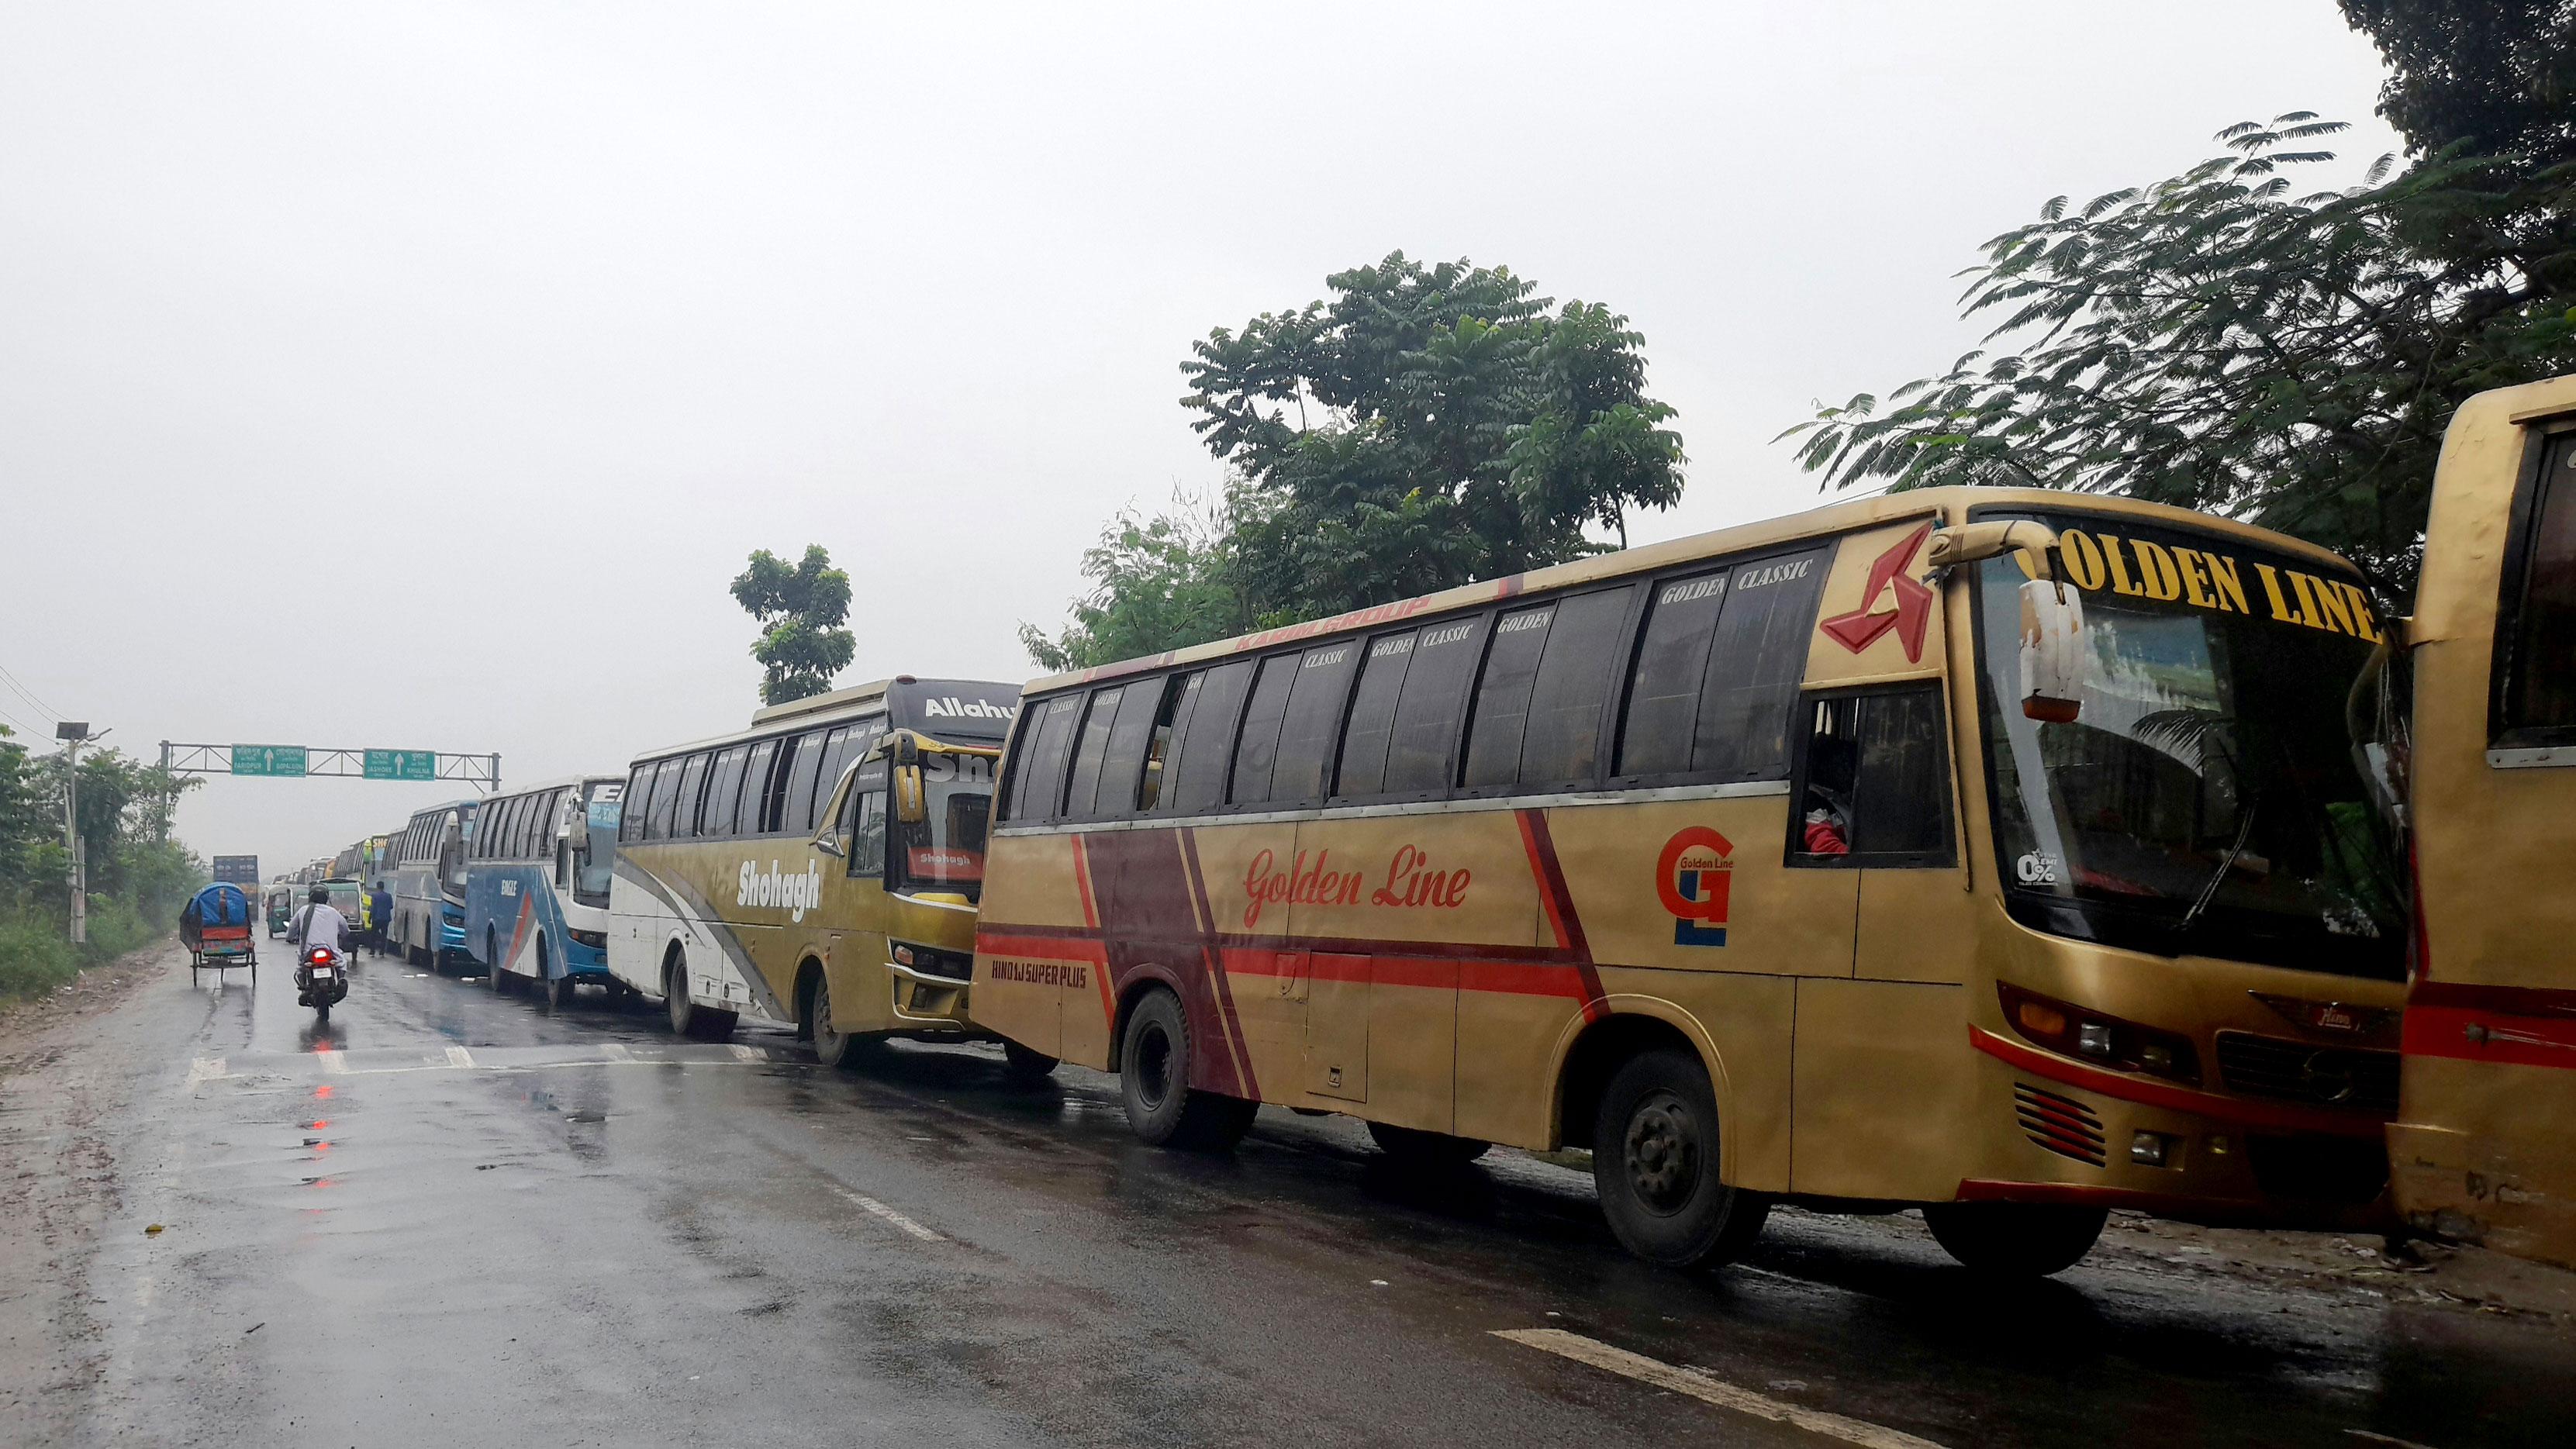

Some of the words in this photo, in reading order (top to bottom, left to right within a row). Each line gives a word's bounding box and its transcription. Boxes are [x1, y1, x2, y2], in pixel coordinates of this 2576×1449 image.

[1661, 578, 1725, 605] GOLDEN
[1738, 558, 1815, 590] CLASSIC
[2015, 528, 2250, 615] OLDEN
[2253, 563, 2383, 645] LINE
[1321, 596, 1432, 630] GROUP
[1497, 611, 1552, 634] GOLDEN
[1371, 638, 1414, 657] GOLDEN
[1422, 624, 1473, 647] CLASSIC
[1304, 649, 1348, 668] CLASSIC
[920, 853, 971, 866] Shohagh
[1680, 857, 1713, 869] Golden
[1715, 857, 1734, 869] Line
[737, 858, 820, 923] Shohagh
[1243, 848, 1362, 929] Golden
[1372, 844, 1471, 907] Line
[1026, 963, 1058, 985] SUPER
[1059, 966, 1086, 989] PLUS
